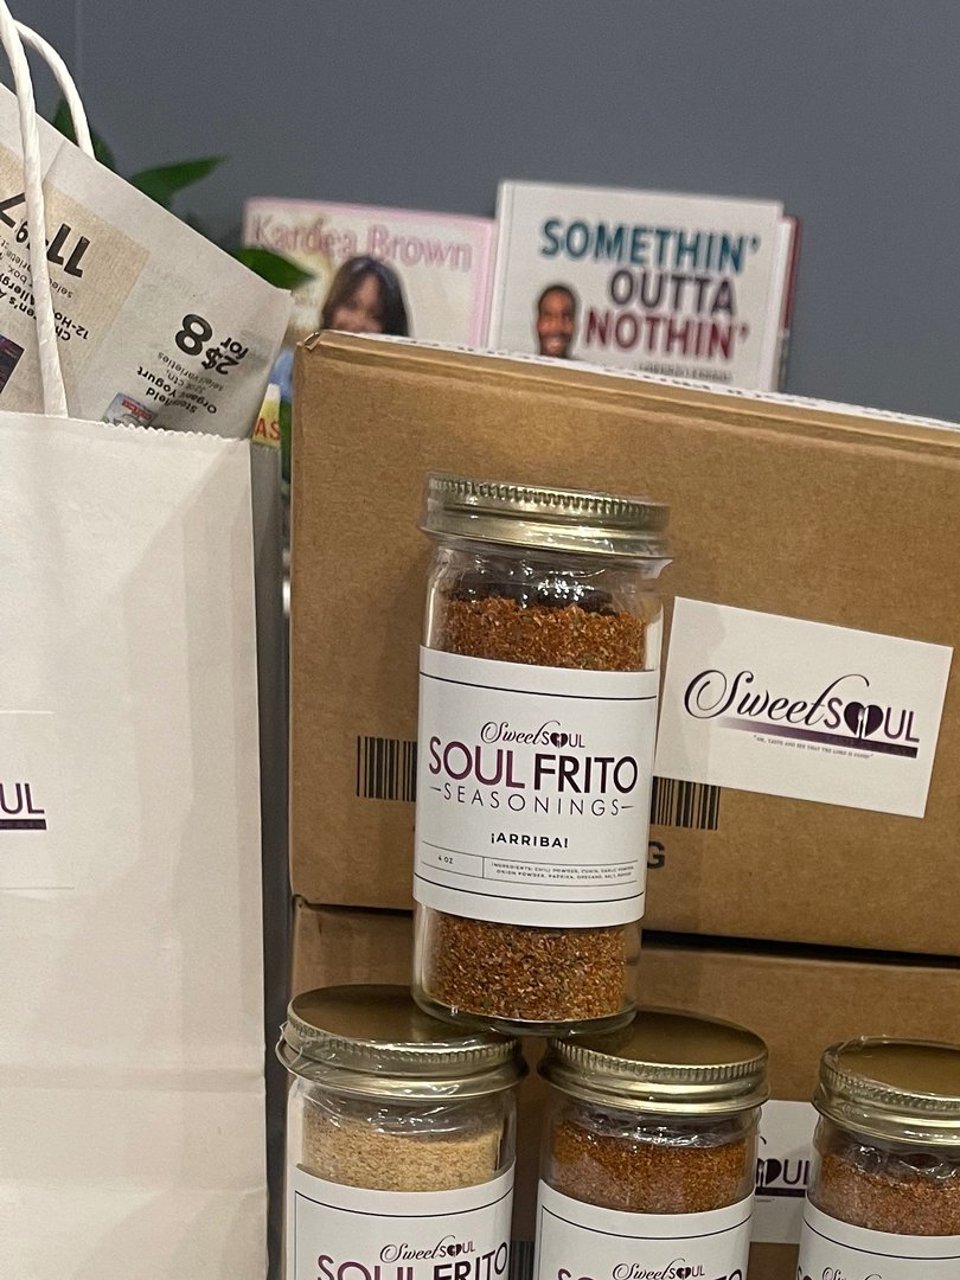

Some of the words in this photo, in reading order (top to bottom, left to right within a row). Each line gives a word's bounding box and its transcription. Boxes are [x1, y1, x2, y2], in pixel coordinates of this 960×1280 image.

[254, 213, 358, 257] Kardea
[366, 228, 472, 273] Brown
[540, 216, 761, 273] SOMETHIN'
[609, 268, 736, 316] OUTTA
[219, 336, 249, 360] for
[581, 308, 750, 361] NOTHIN'
[136, 365, 177, 399] Yogurt
[428, 736, 526, 789] SOUL
[533, 752, 639, 794] FRITO
[442, 782, 620, 818] SEASONINGS
[443, 857, 454, 865] OZ
[490, 832, 569, 850] ¡ARRIBA!
